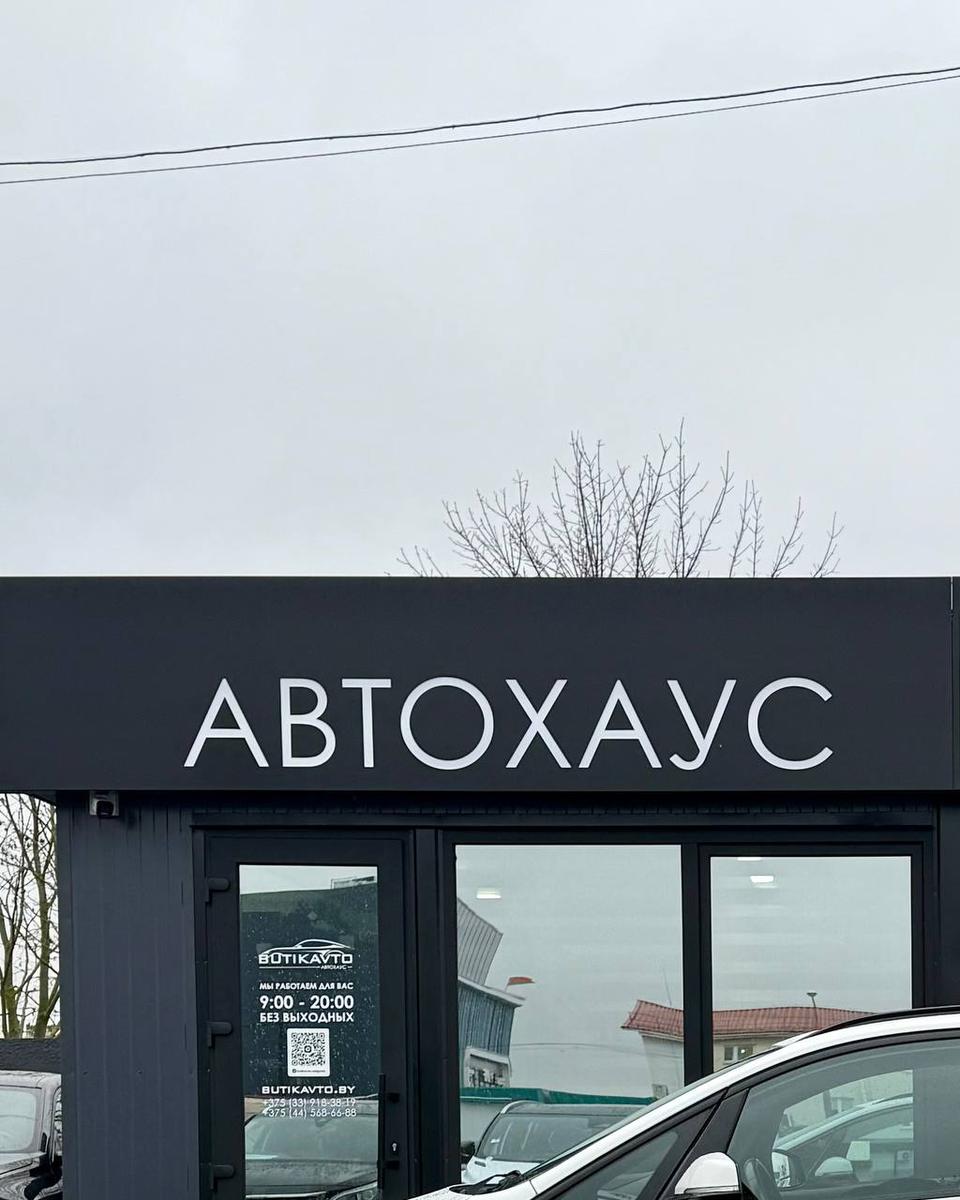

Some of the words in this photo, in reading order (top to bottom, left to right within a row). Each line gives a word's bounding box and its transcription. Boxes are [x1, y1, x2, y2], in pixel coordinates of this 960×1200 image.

[183, 677, 834, 772] АВТОХАУС
[258, 954, 353, 965] BUTIKAVTO
[259, 995, 294, 1009] 9:00
[310, 995, 354, 1009] 20:00
[260, 1012, 280, 1023] БЕЗ
[283, 1012, 354, 1023] ВЫХОДНЫХ
[261, 1086, 356, 1094] BUTIKAVTO.BY
[288, 1108, 307, 1119] (44)
[309, 1108, 357, 1118] 568-66-88
